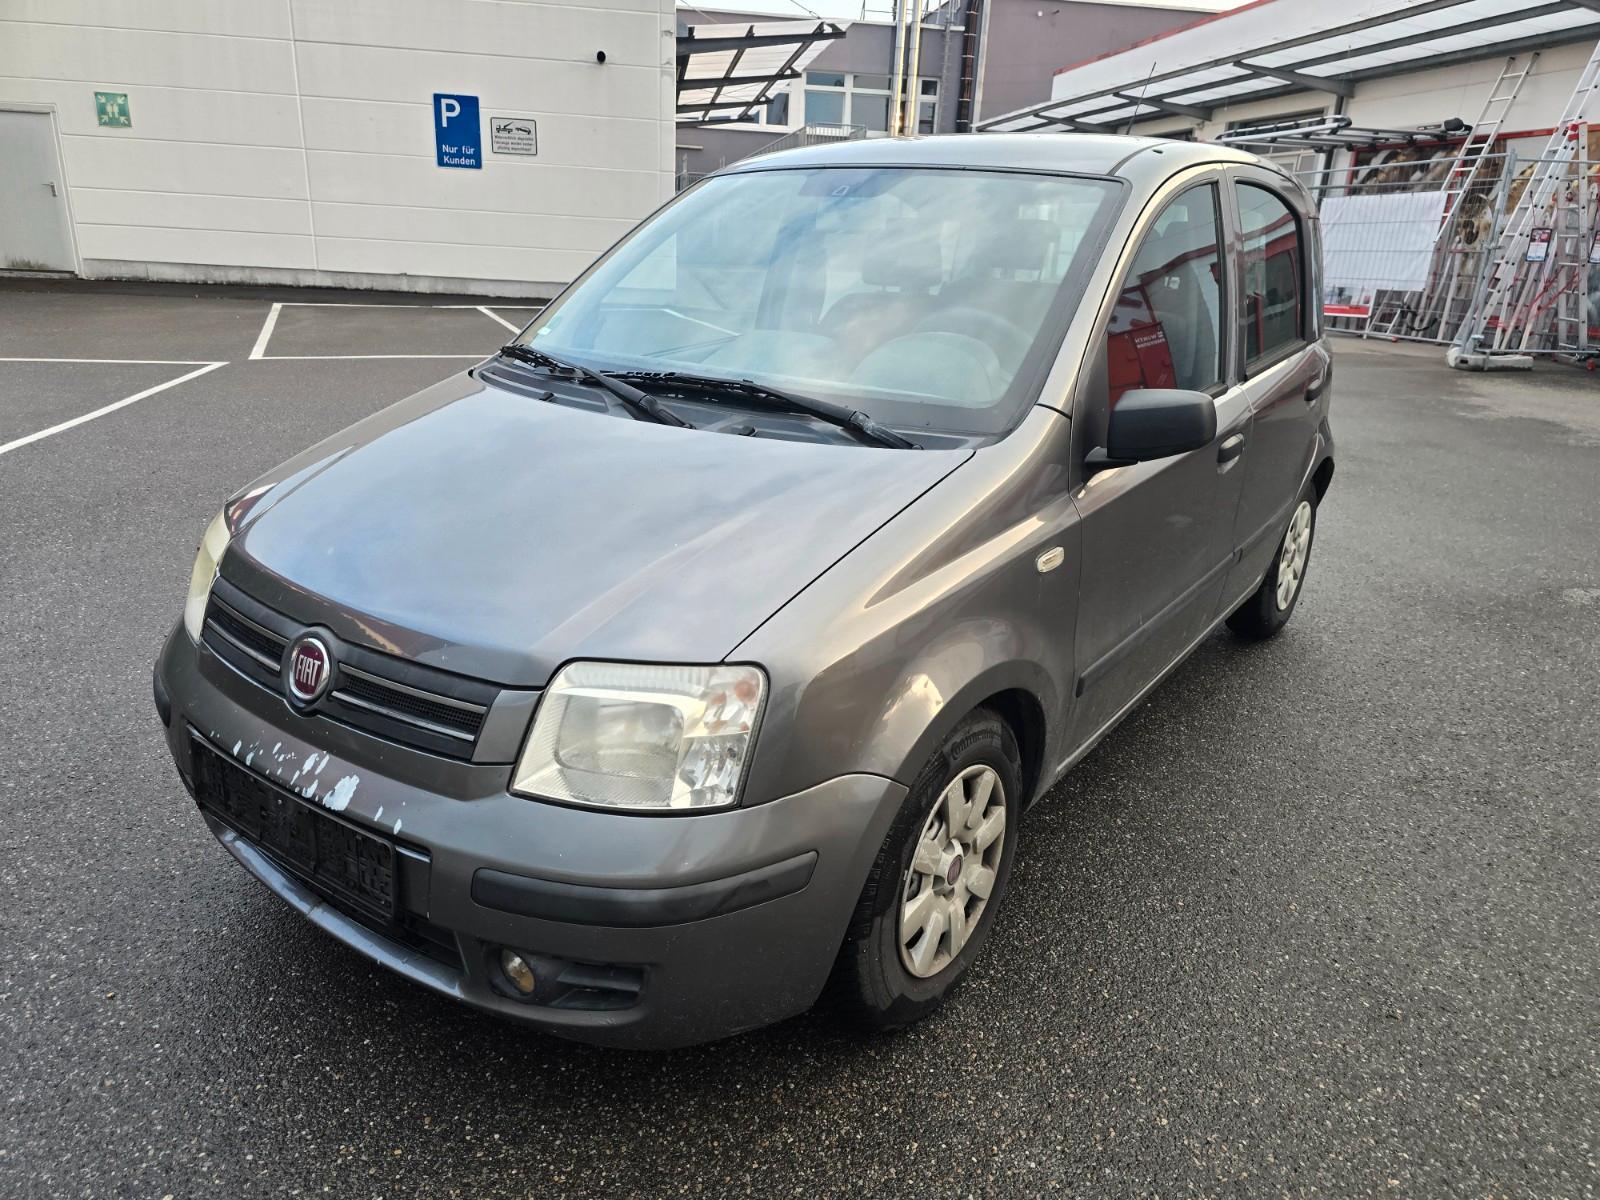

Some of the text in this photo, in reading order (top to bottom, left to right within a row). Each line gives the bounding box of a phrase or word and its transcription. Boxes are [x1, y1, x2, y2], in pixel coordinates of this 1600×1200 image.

[441, 98, 461, 128] P
[442, 144, 475, 155] Nur für
[443, 155, 476, 166] Kunden
[296, 654, 321, 687] FIAT
